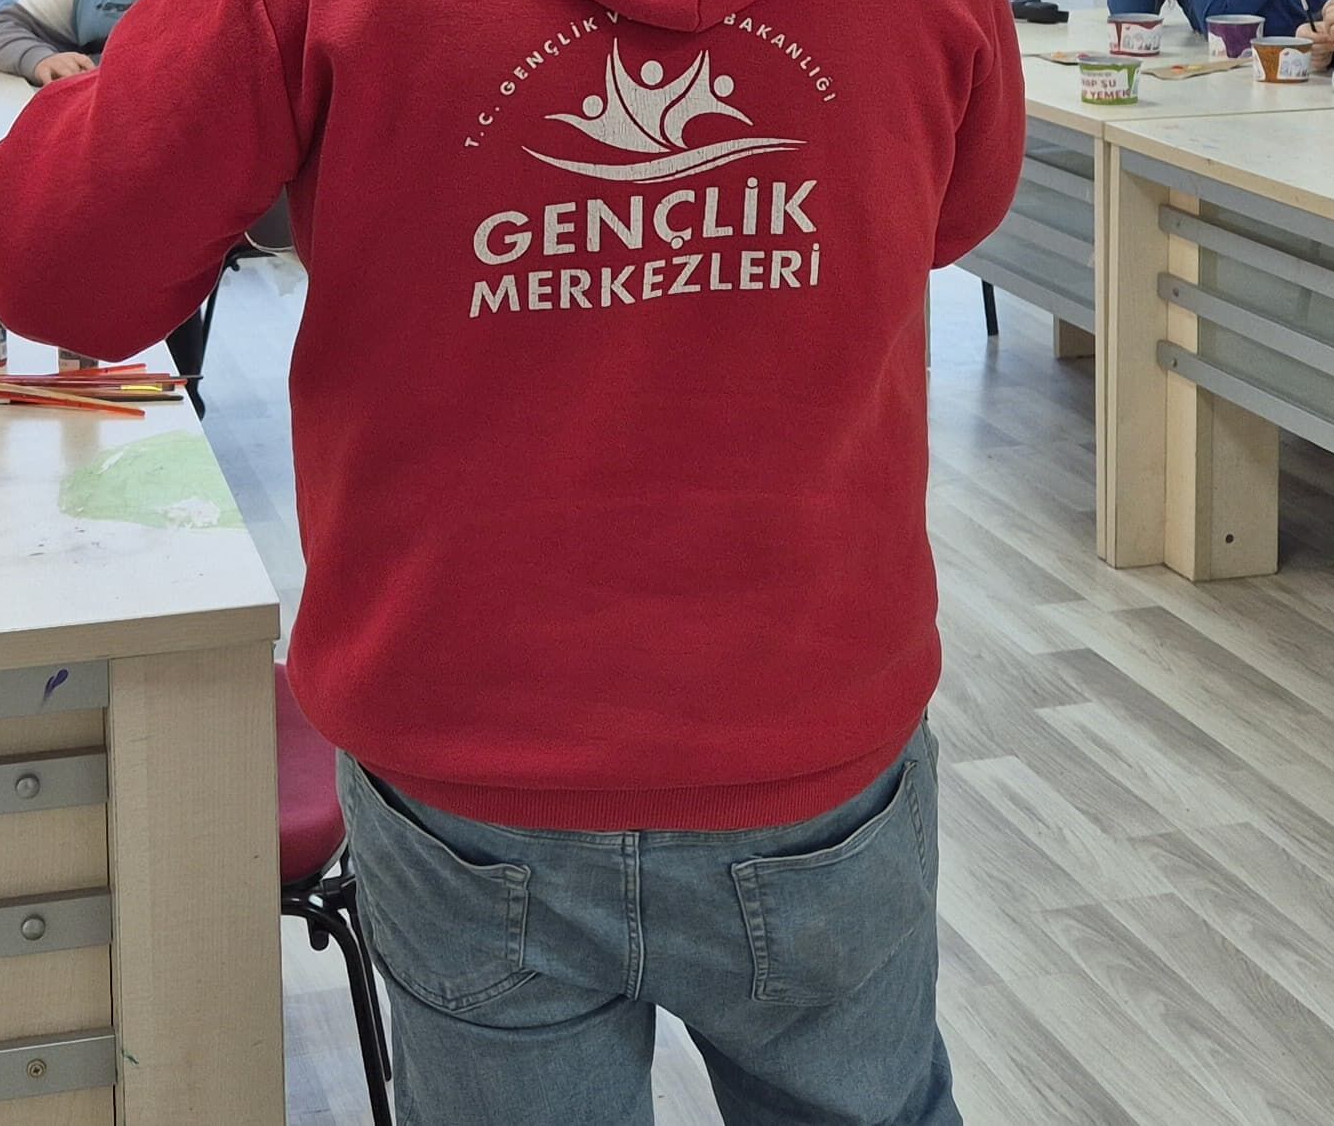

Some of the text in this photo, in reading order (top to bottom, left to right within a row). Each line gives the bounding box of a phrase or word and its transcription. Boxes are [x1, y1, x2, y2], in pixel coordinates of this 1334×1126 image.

[464, 11, 836, 148] T.C. GENÇLİK V BAKANLIĞI
[473, 176, 818, 266] GENÇLİK
[469, 242, 821, 318] MERKEZLERİ
